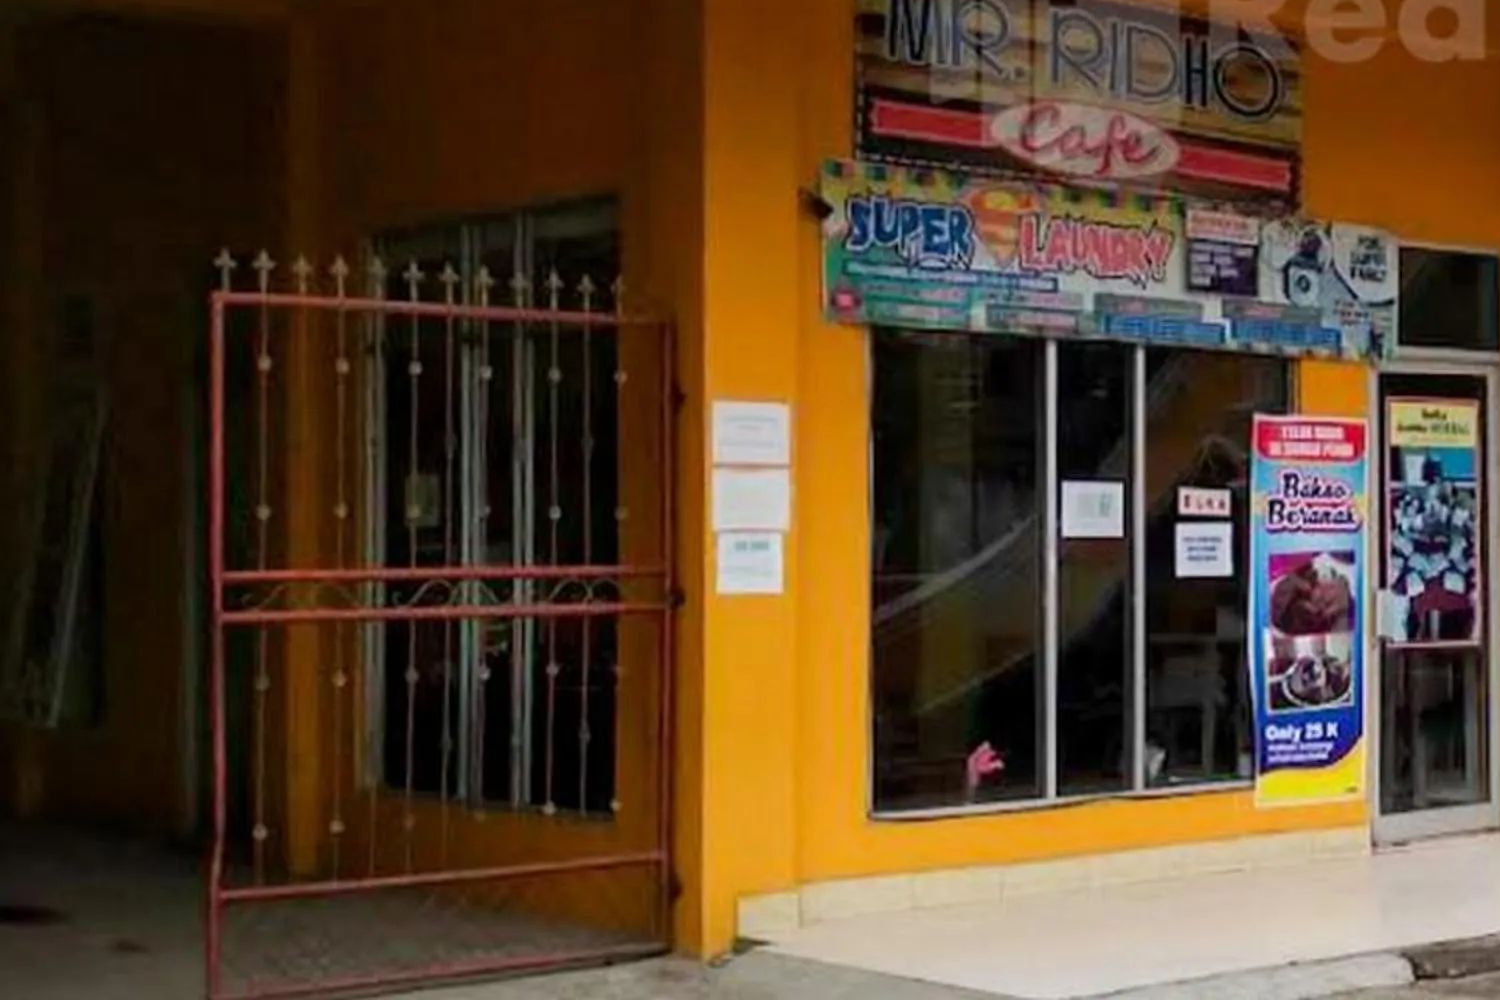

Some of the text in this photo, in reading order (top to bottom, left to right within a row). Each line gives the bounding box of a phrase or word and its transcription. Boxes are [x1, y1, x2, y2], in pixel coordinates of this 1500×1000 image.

[1048, 8, 1288, 121] RIDHO
[1020, 101, 1157, 175] Cafe
[846, 197, 974, 270] SUPER
[1020, 214, 1174, 290] LAUNDRY
[1283, 472, 1346, 499] Bakso
[1265, 725, 1302, 743] Only
